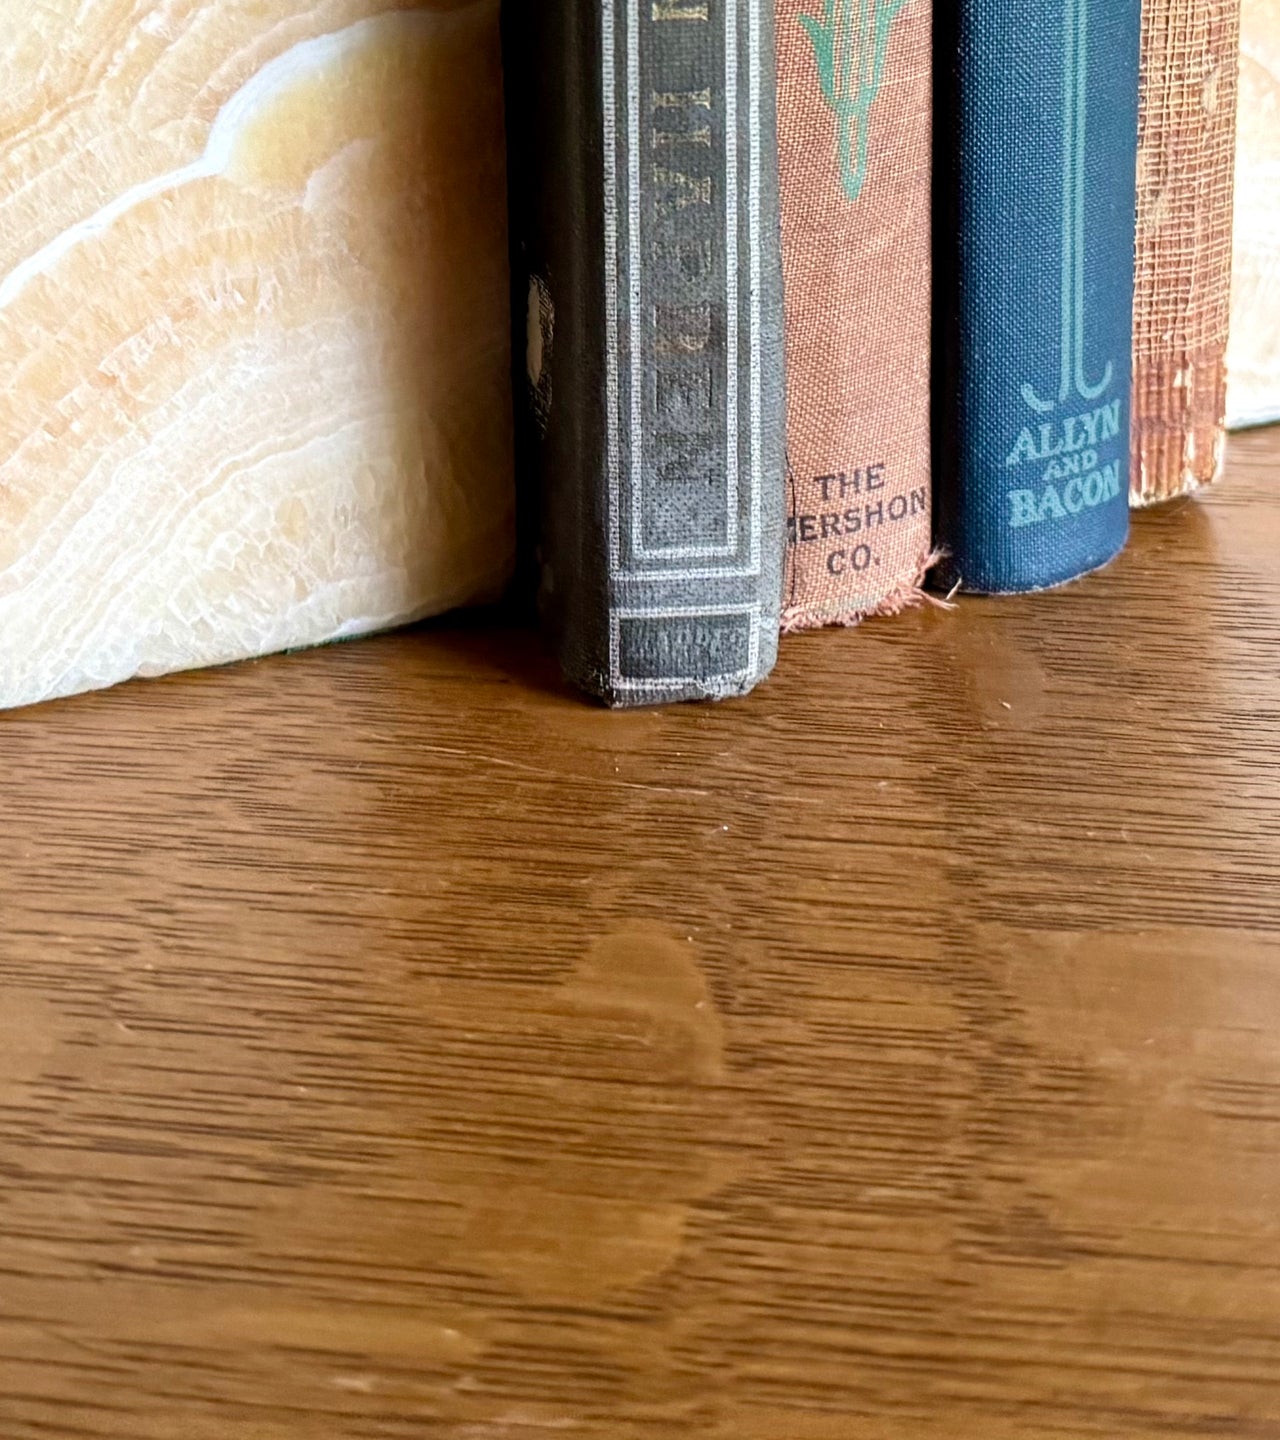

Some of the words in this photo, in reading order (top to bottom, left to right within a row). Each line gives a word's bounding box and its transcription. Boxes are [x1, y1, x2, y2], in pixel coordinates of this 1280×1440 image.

[1006, 398, 1121, 466] ALLYN
[814, 462, 886, 501] THE
[1042, 449, 1098, 481] AND
[1006, 459, 1121, 528] BACON
[826, 543, 881, 575] CO.
